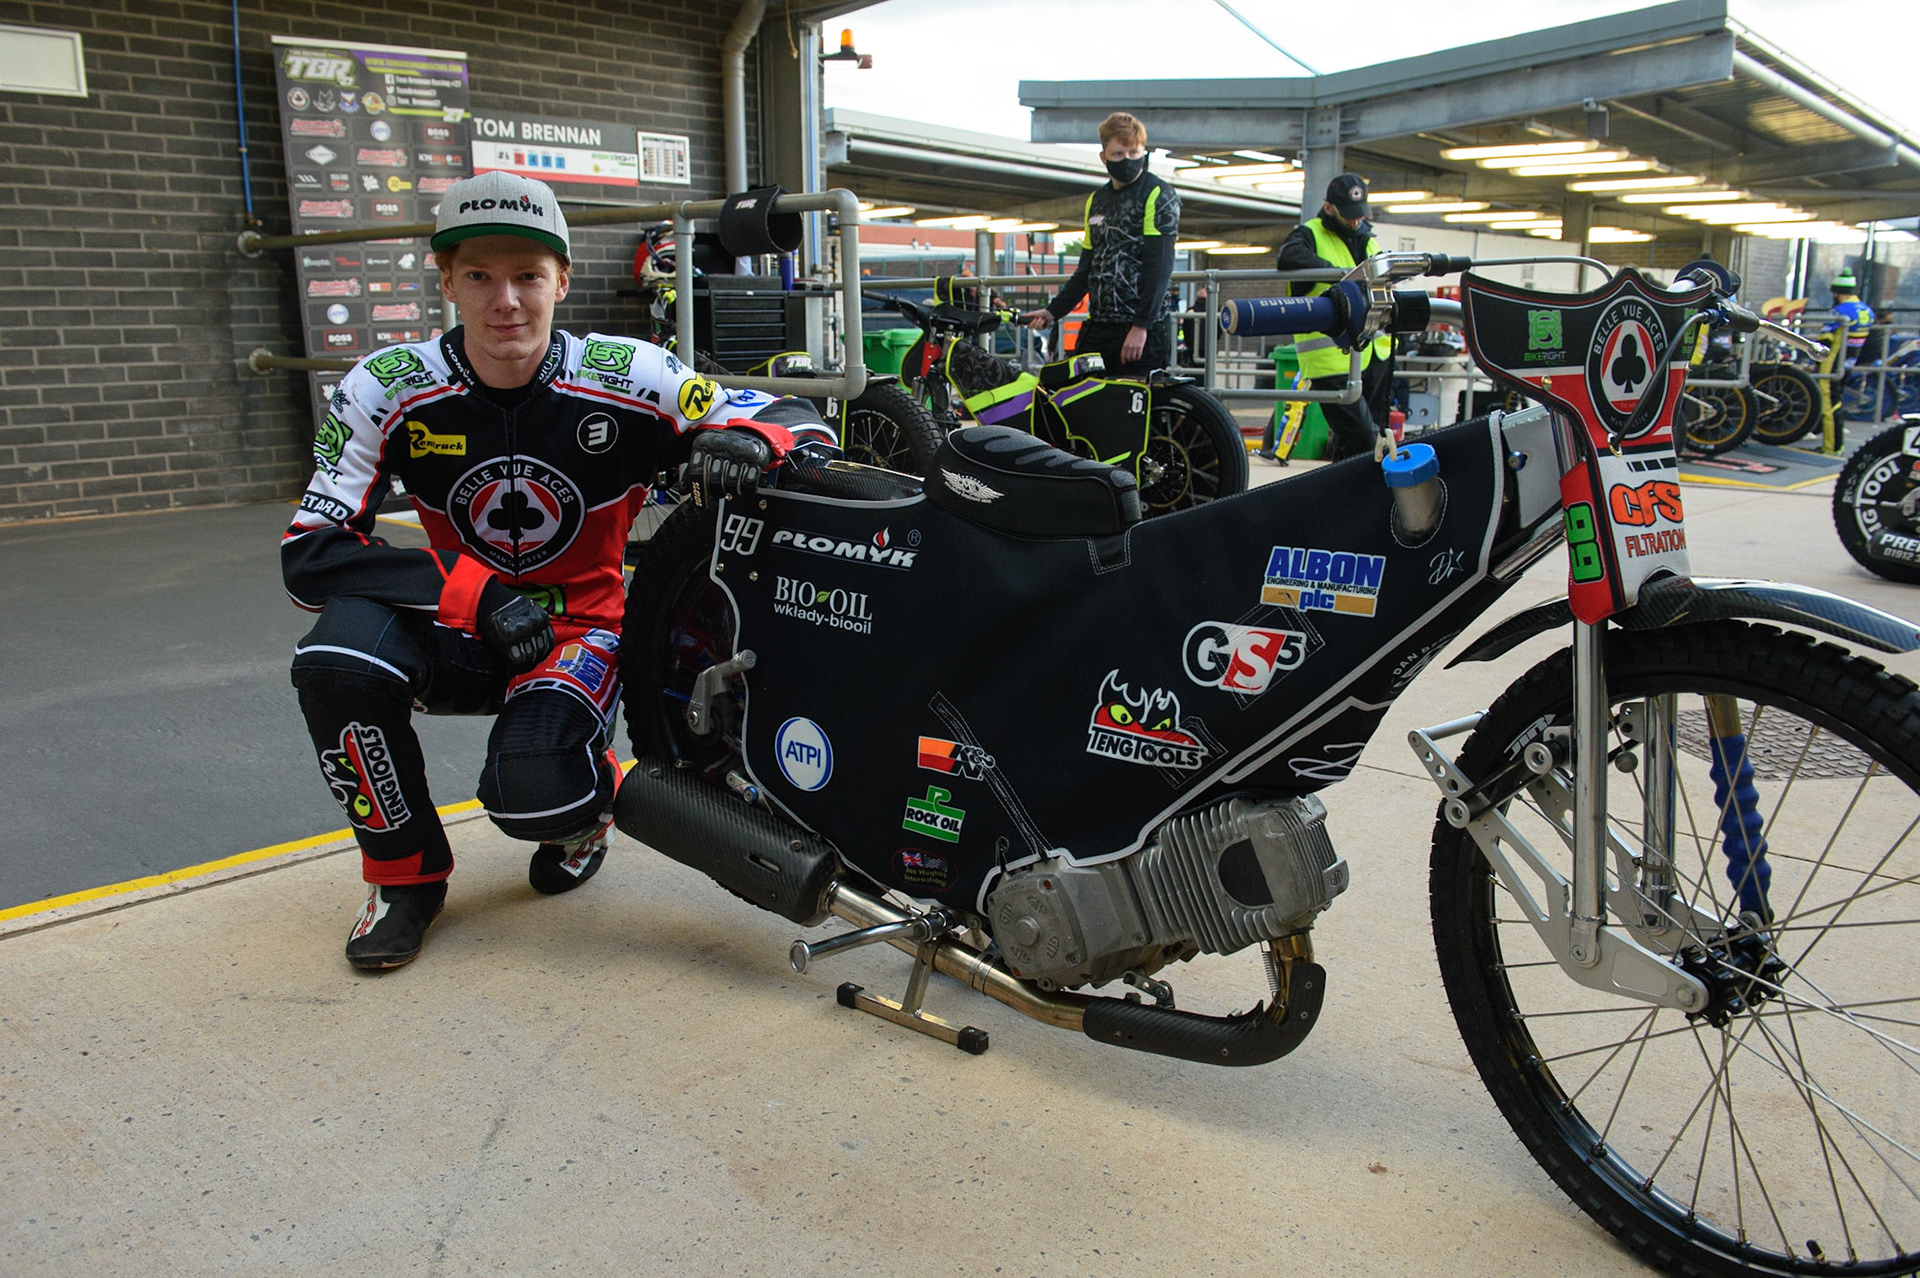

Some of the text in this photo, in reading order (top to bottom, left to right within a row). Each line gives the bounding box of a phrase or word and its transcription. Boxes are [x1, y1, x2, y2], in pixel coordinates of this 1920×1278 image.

[427, 127, 450, 137] BOSS
[473, 117, 601, 146] TOM BRENNAN
[376, 203, 399, 213] BOSS
[328, 334, 353, 343] BOSS
[1593, 304, 1664, 355] BELLE VUE ACES
[827, 397, 838, 418] 6
[1131, 391, 1143, 414] 6
[455, 463, 575, 506] BELLE VUE ACES
[300, 494, 348, 521] ETARD
[1609, 479, 1684, 527] CFS
[720, 514, 764, 555] 99
[1625, 528, 1687, 558] FILTRATION
[1267, 547, 1385, 588] ALBON
[774, 575, 873, 621] BIO OIL
[1266, 576, 1309, 588] ENGINEERING
[1317, 581, 1377, 595] MANUFACTURING
[1299, 589, 1335, 610] plc
[773, 602, 872, 635] wkłady-biooil
[1393, 652, 1418, 675] DAN
[785, 740, 821, 769] ATPI
[906, 808, 960, 834] ROCK OIL
